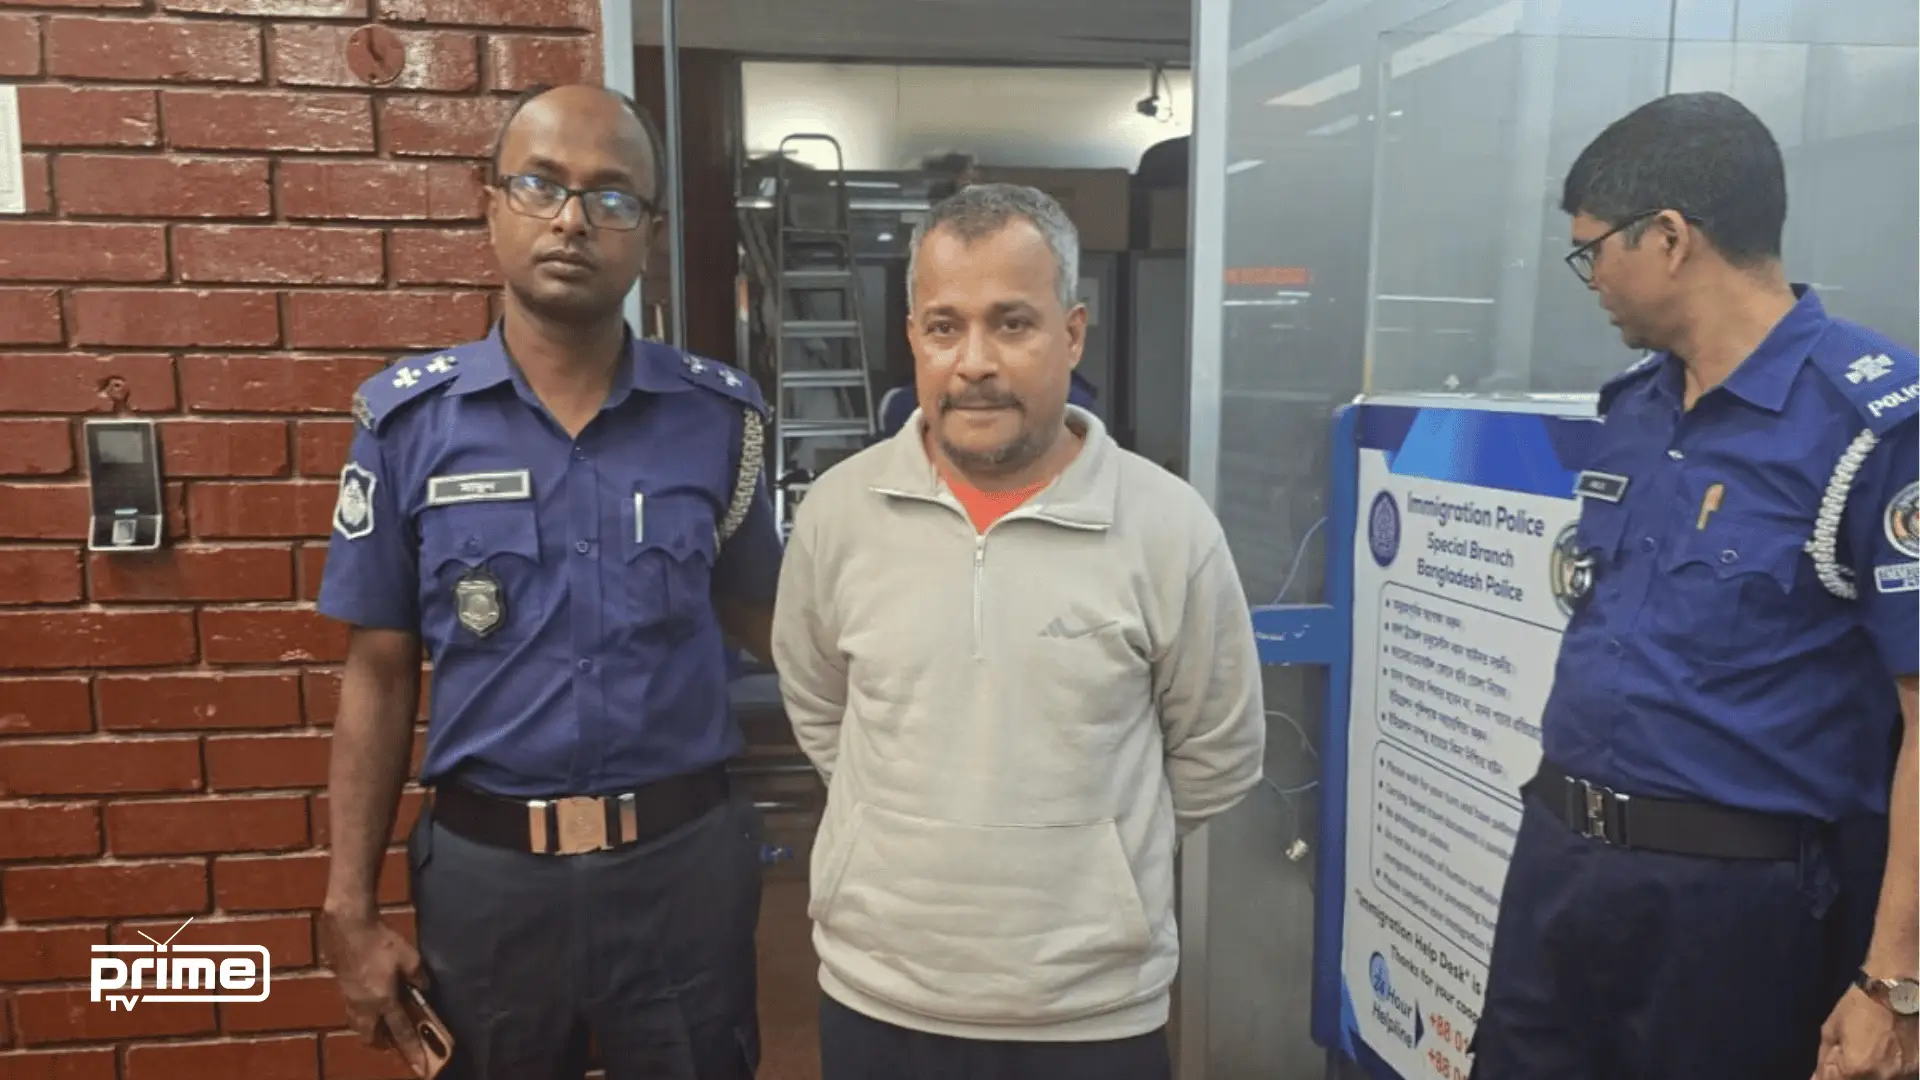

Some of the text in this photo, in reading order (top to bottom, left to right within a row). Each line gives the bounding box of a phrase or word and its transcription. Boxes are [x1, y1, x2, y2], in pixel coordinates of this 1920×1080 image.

[1407, 492, 1544, 537] Immigration Police
[1427, 532, 1514, 567] Special Branch
[1417, 558, 1523, 601] Bangladesh Police
[1415, 932, 1437, 963] Help
[1391, 944, 1419, 978] Thanks
[1420, 967, 1434, 988] for
[1435, 981, 1456, 1005] your
[1387, 984, 1413, 1019] Hour
[1372, 1000, 1414, 1049] Helpline
